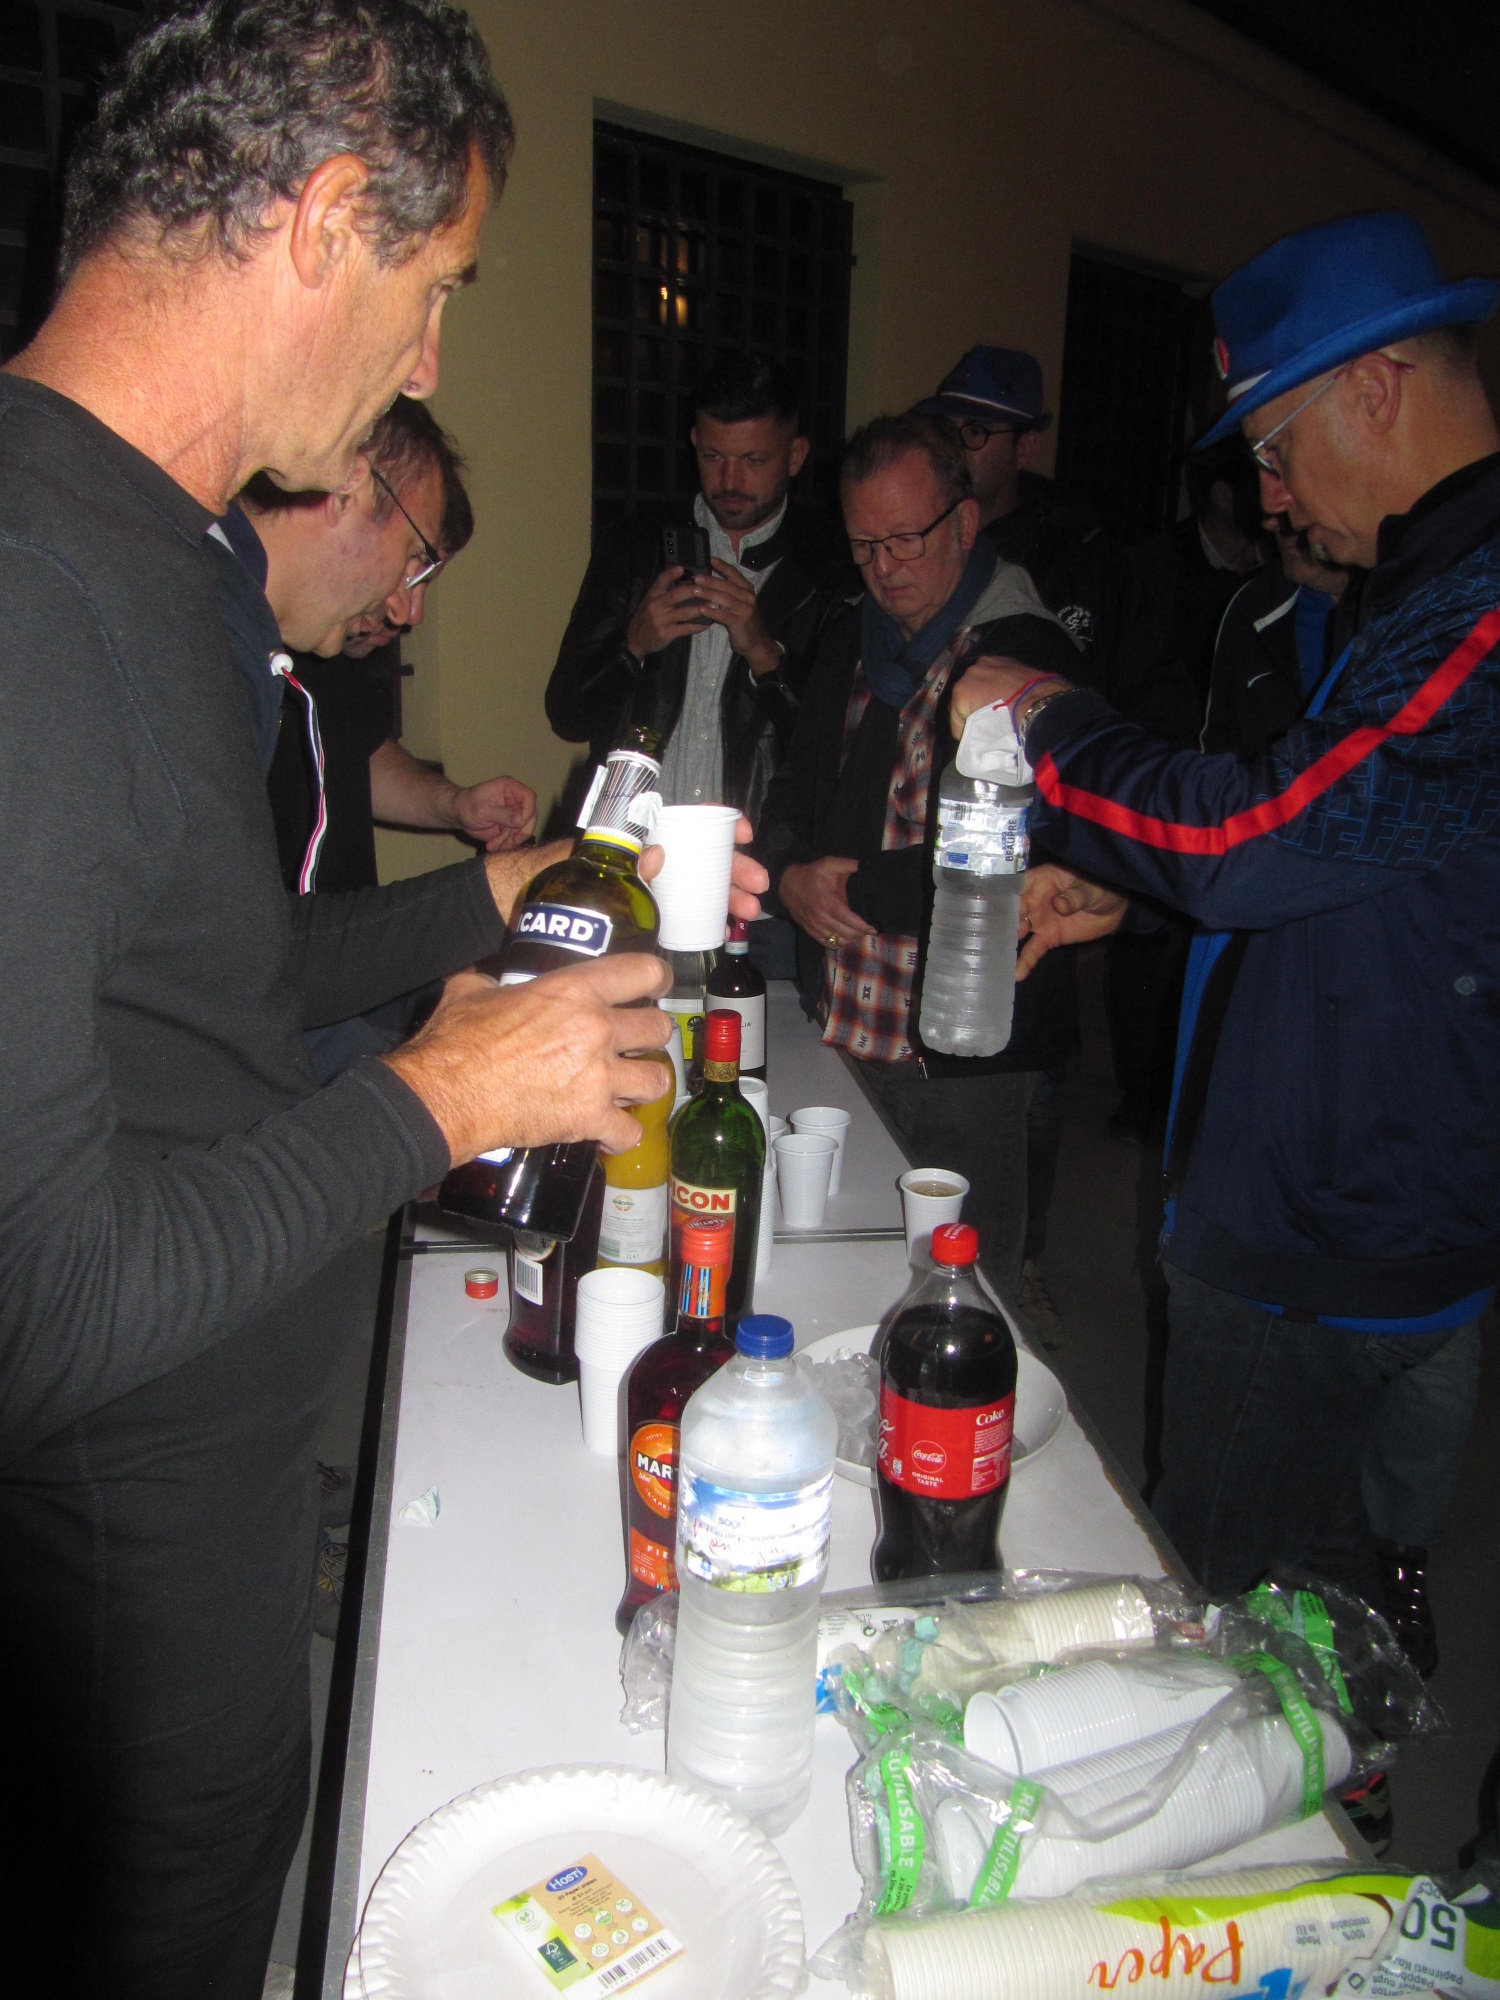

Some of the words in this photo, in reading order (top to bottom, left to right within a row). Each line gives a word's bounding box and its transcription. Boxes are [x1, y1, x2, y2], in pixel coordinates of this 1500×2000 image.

[516, 912, 594, 942] CARD
[671, 1180, 730, 1211] ICON
[976, 1409, 1004, 1426] Coke
[913, 1449, 944, 1463] Coca-Cola
[637, 1452, 677, 1481] MAR
[912, 1471, 944, 1483] ORIGINAL
[917, 1479, 938, 1487] TASTE
[647, 1544, 669, 1559] FIE
[1400, 1896, 1457, 1951] 50
[1296, 1935, 1321, 1946] Made
[1087, 1915, 1244, 1990] Paper
